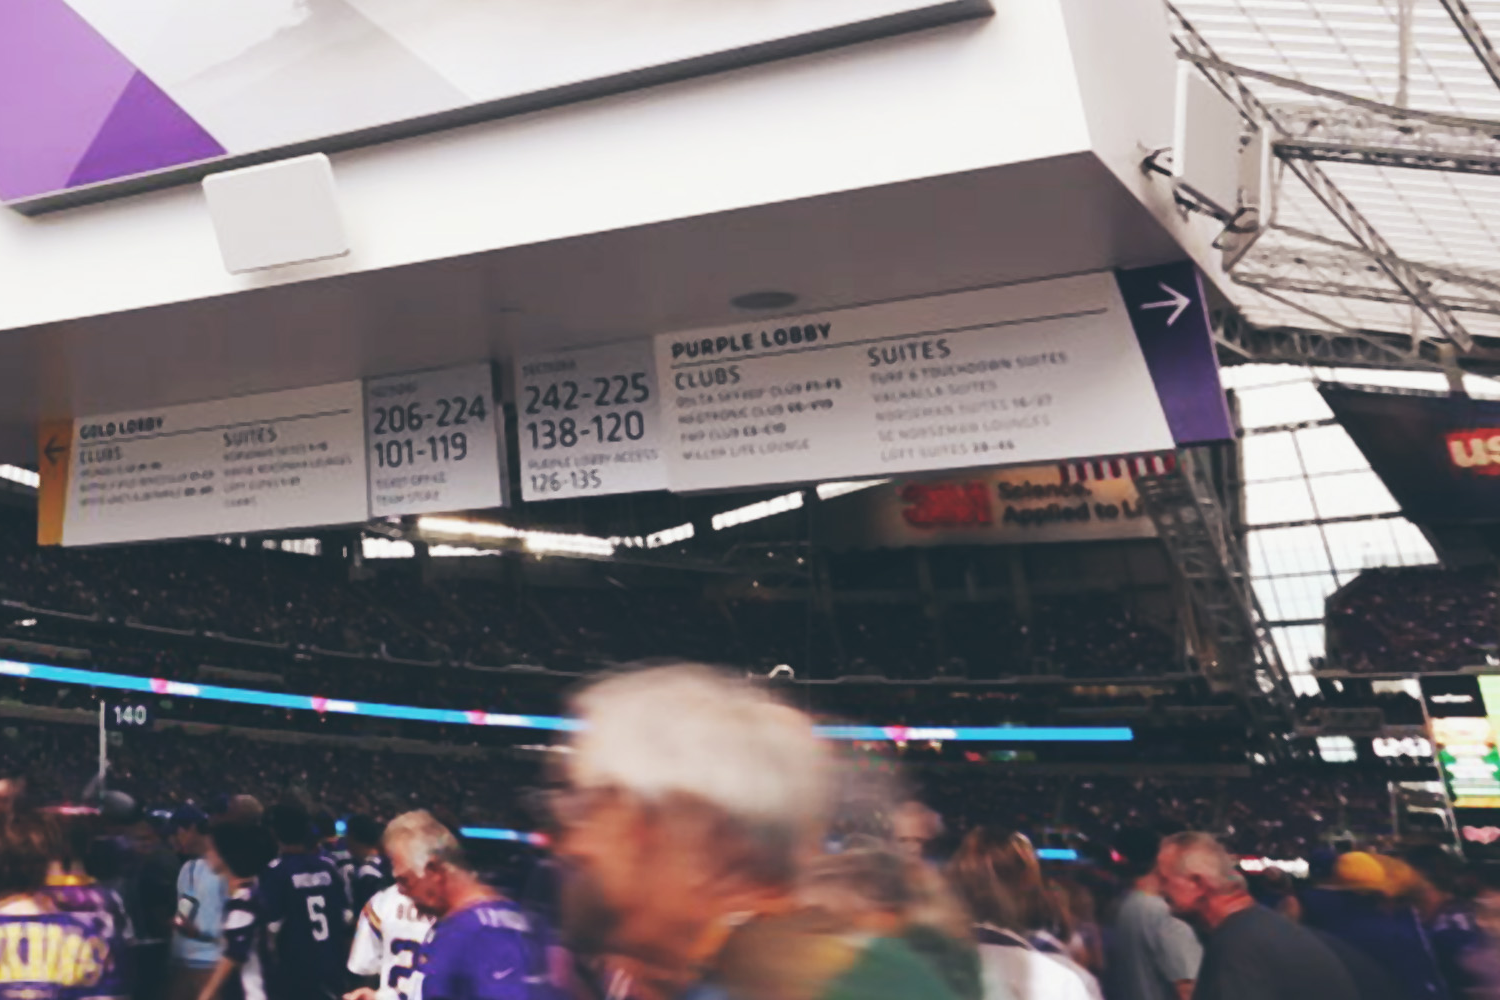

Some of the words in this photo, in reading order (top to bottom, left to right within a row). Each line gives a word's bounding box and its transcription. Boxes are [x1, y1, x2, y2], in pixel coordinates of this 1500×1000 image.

[671, 333, 753, 359] PURPLE
[760, 322, 831, 348] LOBBY
[867, 338, 951, 367] SUITES
[524, 371, 650, 415] 242-225
[675, 365, 741, 390] CLUBS
[373, 394, 487, 435] 206-224
[526, 409, 645, 450] 138-120
[222, 427, 278, 448] SUITES
[374, 431, 468, 468] 101-119
[530, 468, 602, 493] 126-135
[113, 705, 148, 726] 140
[306, 894, 330, 942] 5
